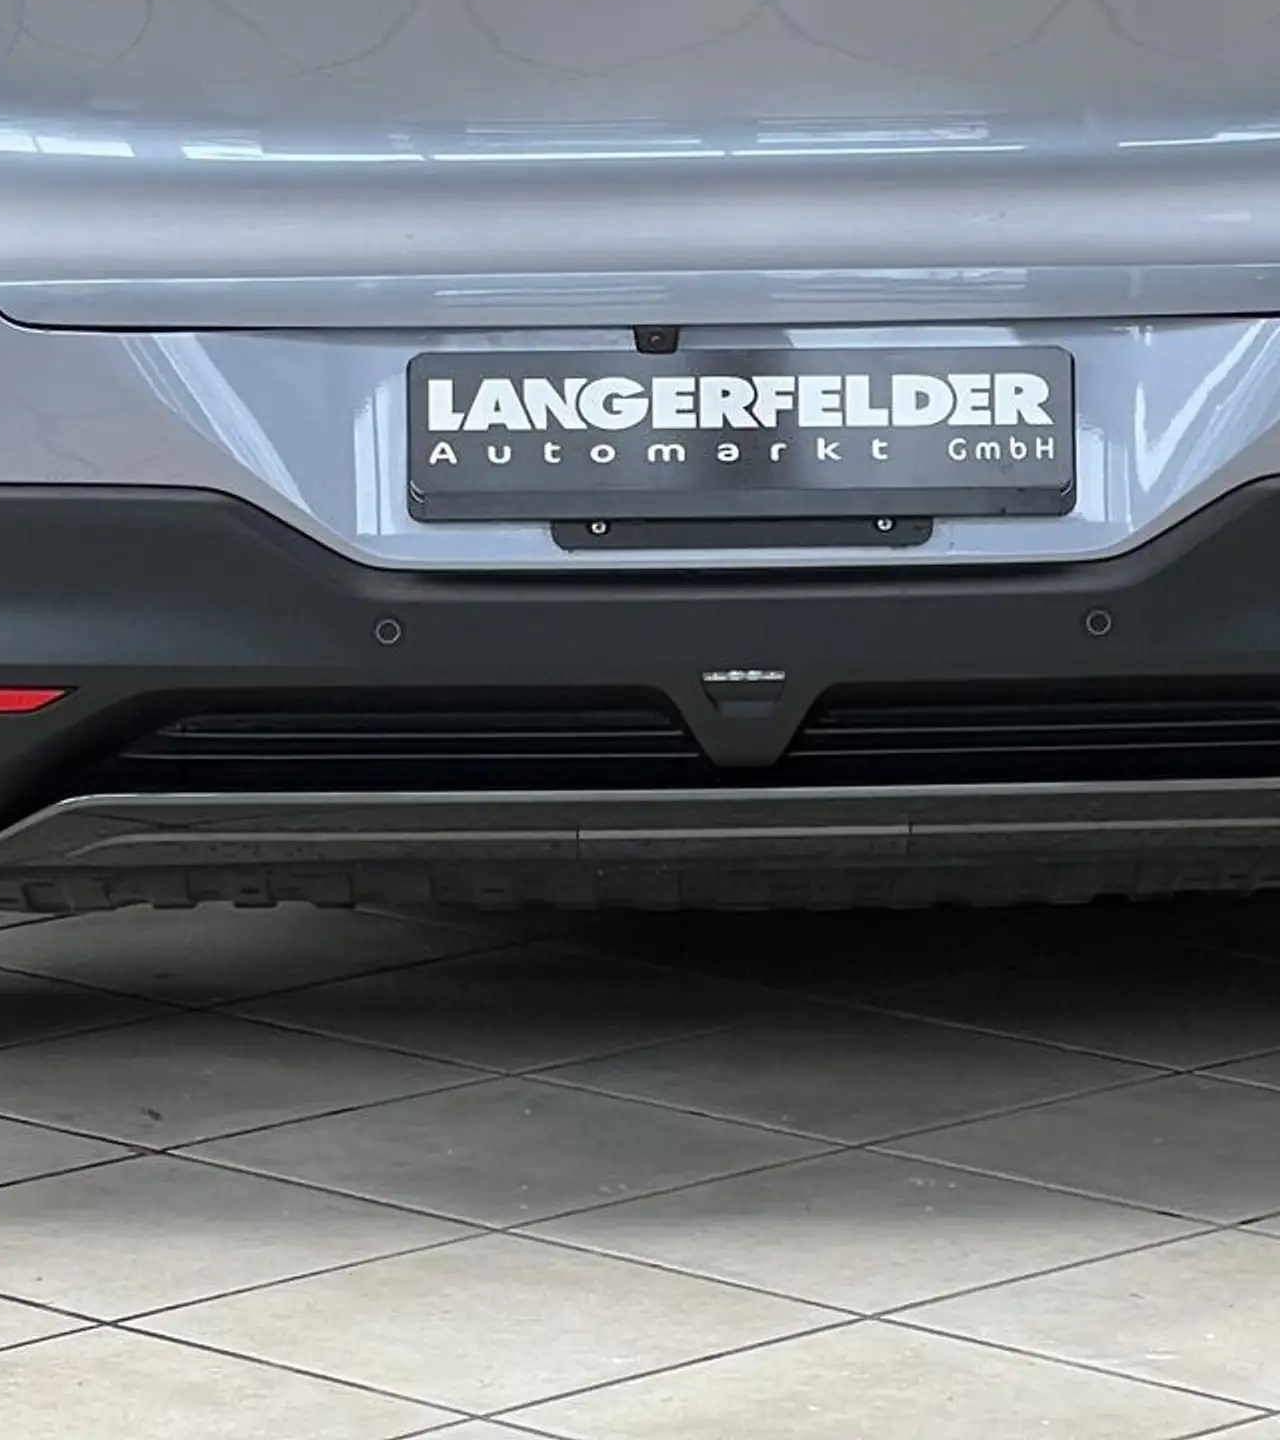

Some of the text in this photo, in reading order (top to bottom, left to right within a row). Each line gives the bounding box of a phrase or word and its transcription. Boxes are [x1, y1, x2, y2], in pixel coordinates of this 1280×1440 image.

[427, 372, 1055, 431] LANGERFELDER
[428, 435, 1055, 465] Automarkt GmbH
